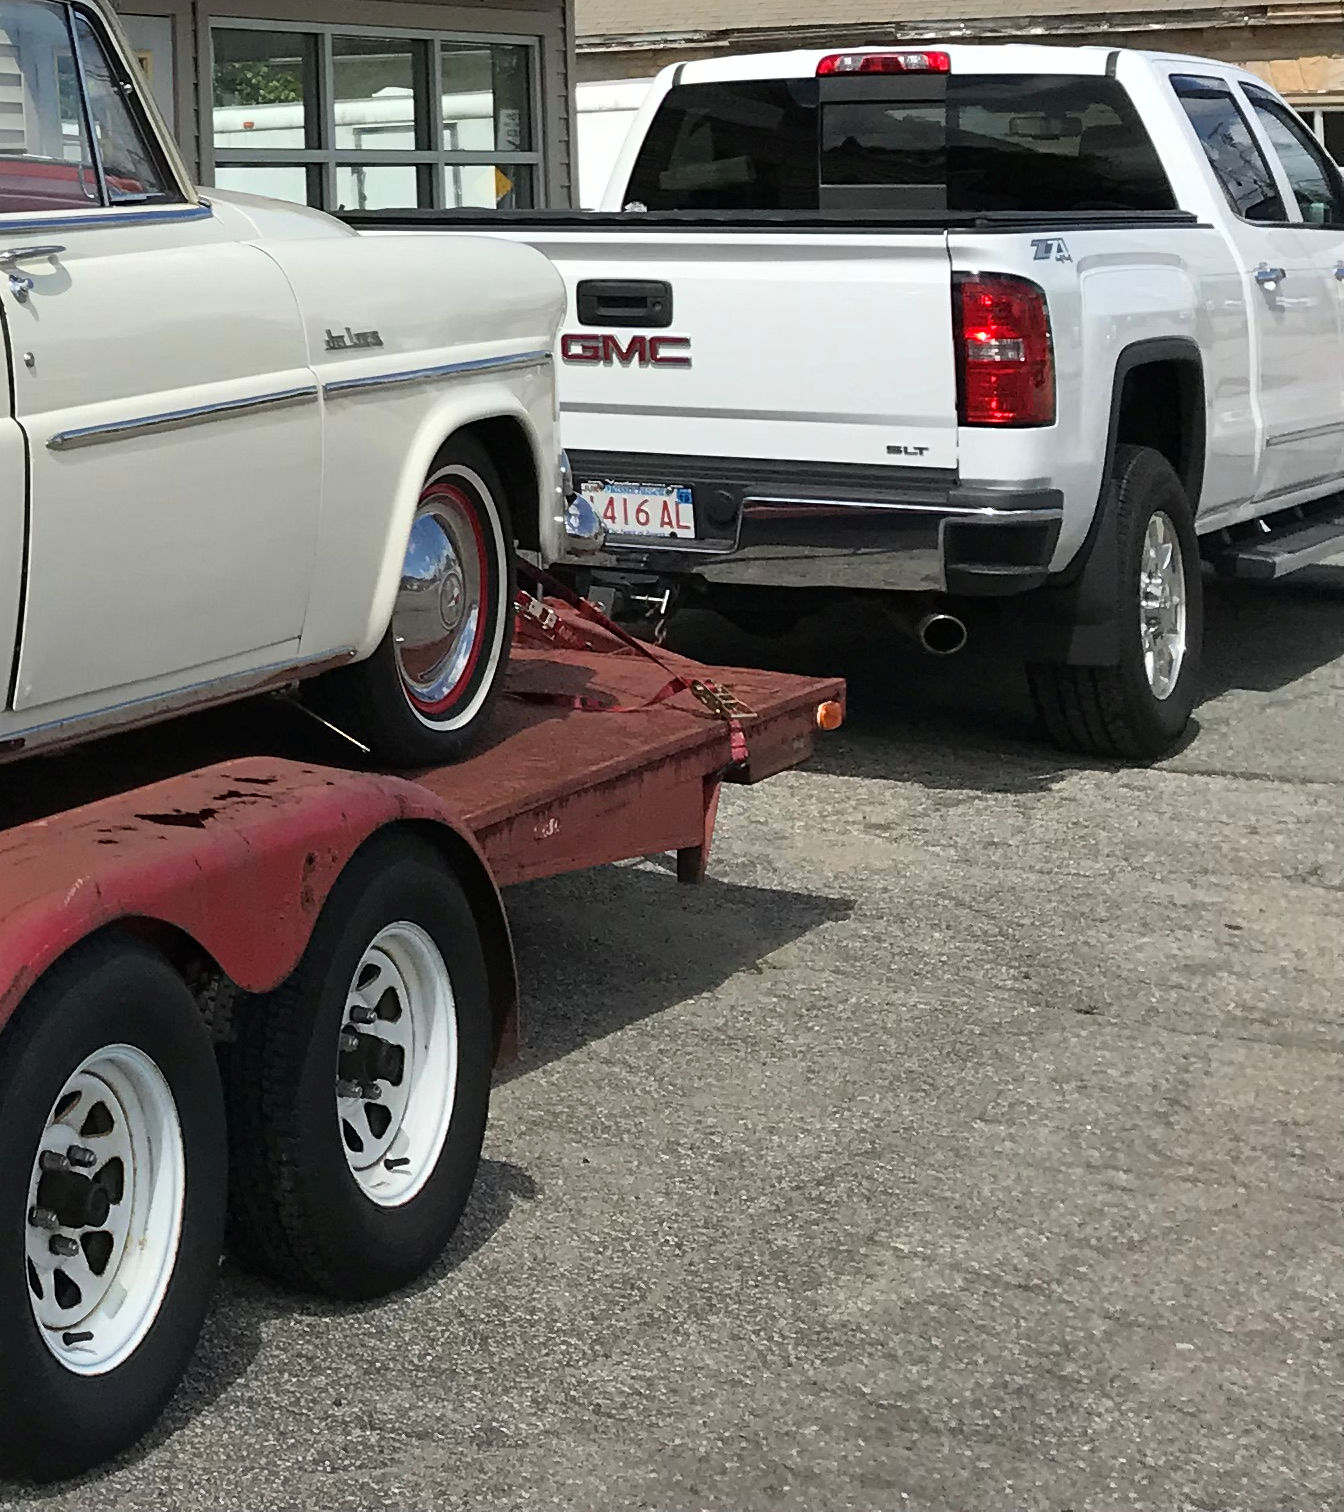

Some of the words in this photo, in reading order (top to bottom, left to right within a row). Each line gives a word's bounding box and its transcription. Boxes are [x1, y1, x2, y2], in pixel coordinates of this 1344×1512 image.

[561, 333, 693, 370] GMC
[886, 445, 929, 456] SLT
[589, 495, 650, 526] 416
[660, 499, 691, 530] AL
